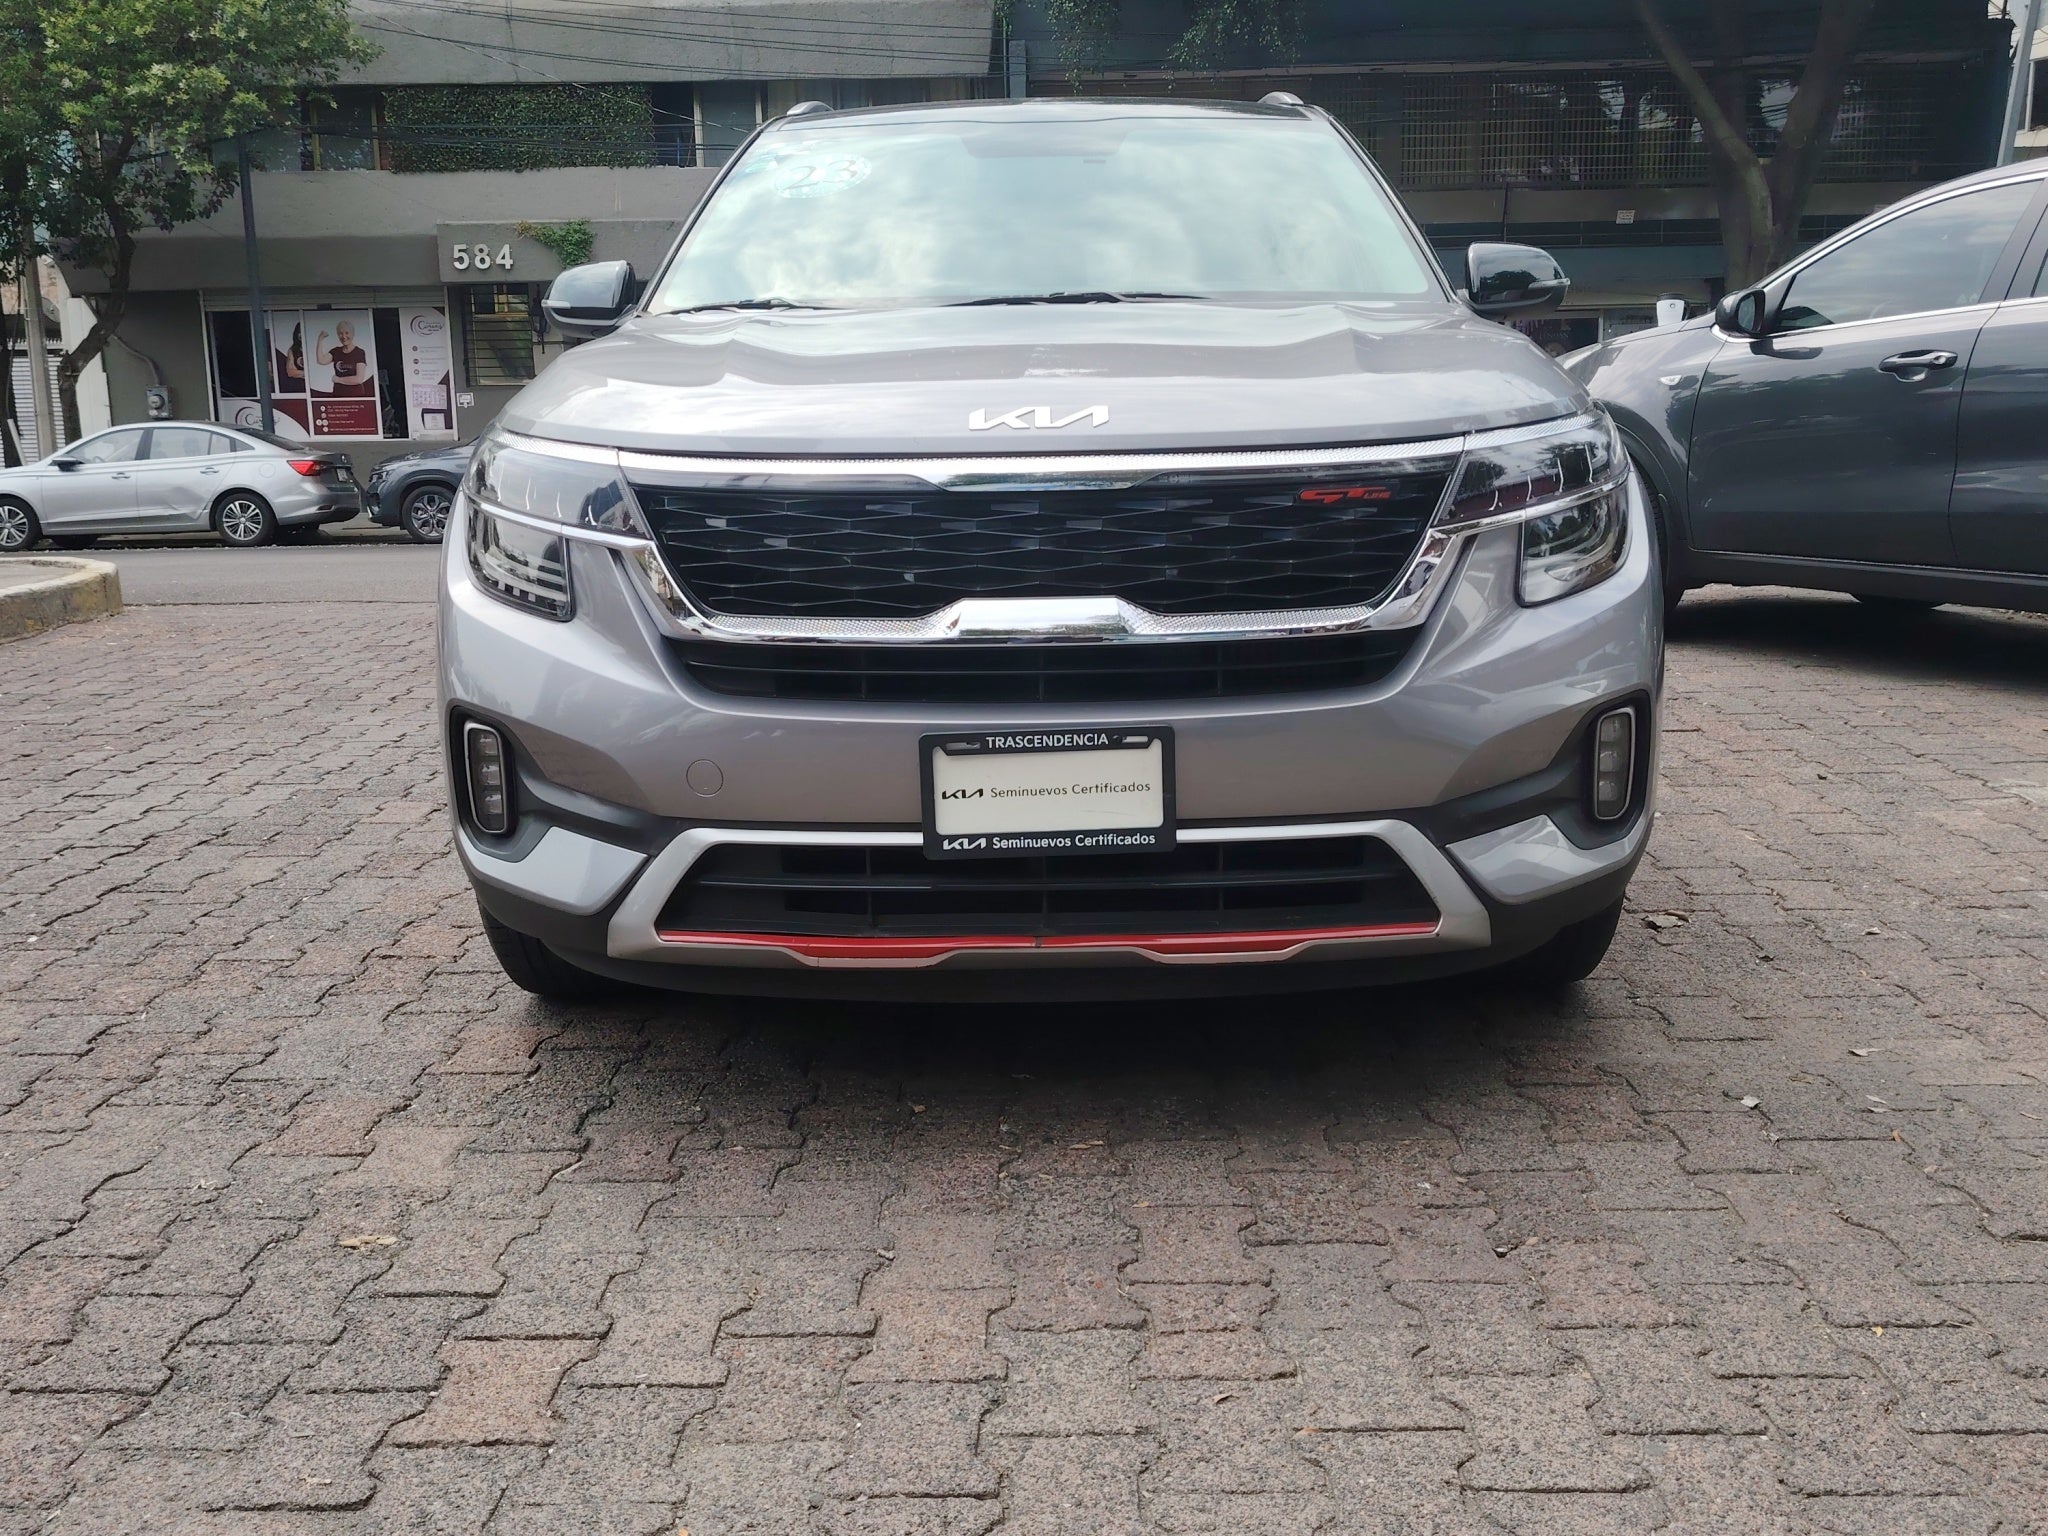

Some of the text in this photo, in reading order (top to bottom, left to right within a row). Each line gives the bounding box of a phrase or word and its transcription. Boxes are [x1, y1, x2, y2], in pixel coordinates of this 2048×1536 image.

[781, 159, 858, 190] 23
[453, 244, 514, 270] 584
[968, 405, 1109, 431] KIA
[986, 733, 1109, 748] TRASCENDENCIA
[942, 781, 1151, 800] KIA Seminuevos Certificados
[943, 833, 1156, 850] KIA Seminuevos Certificados
